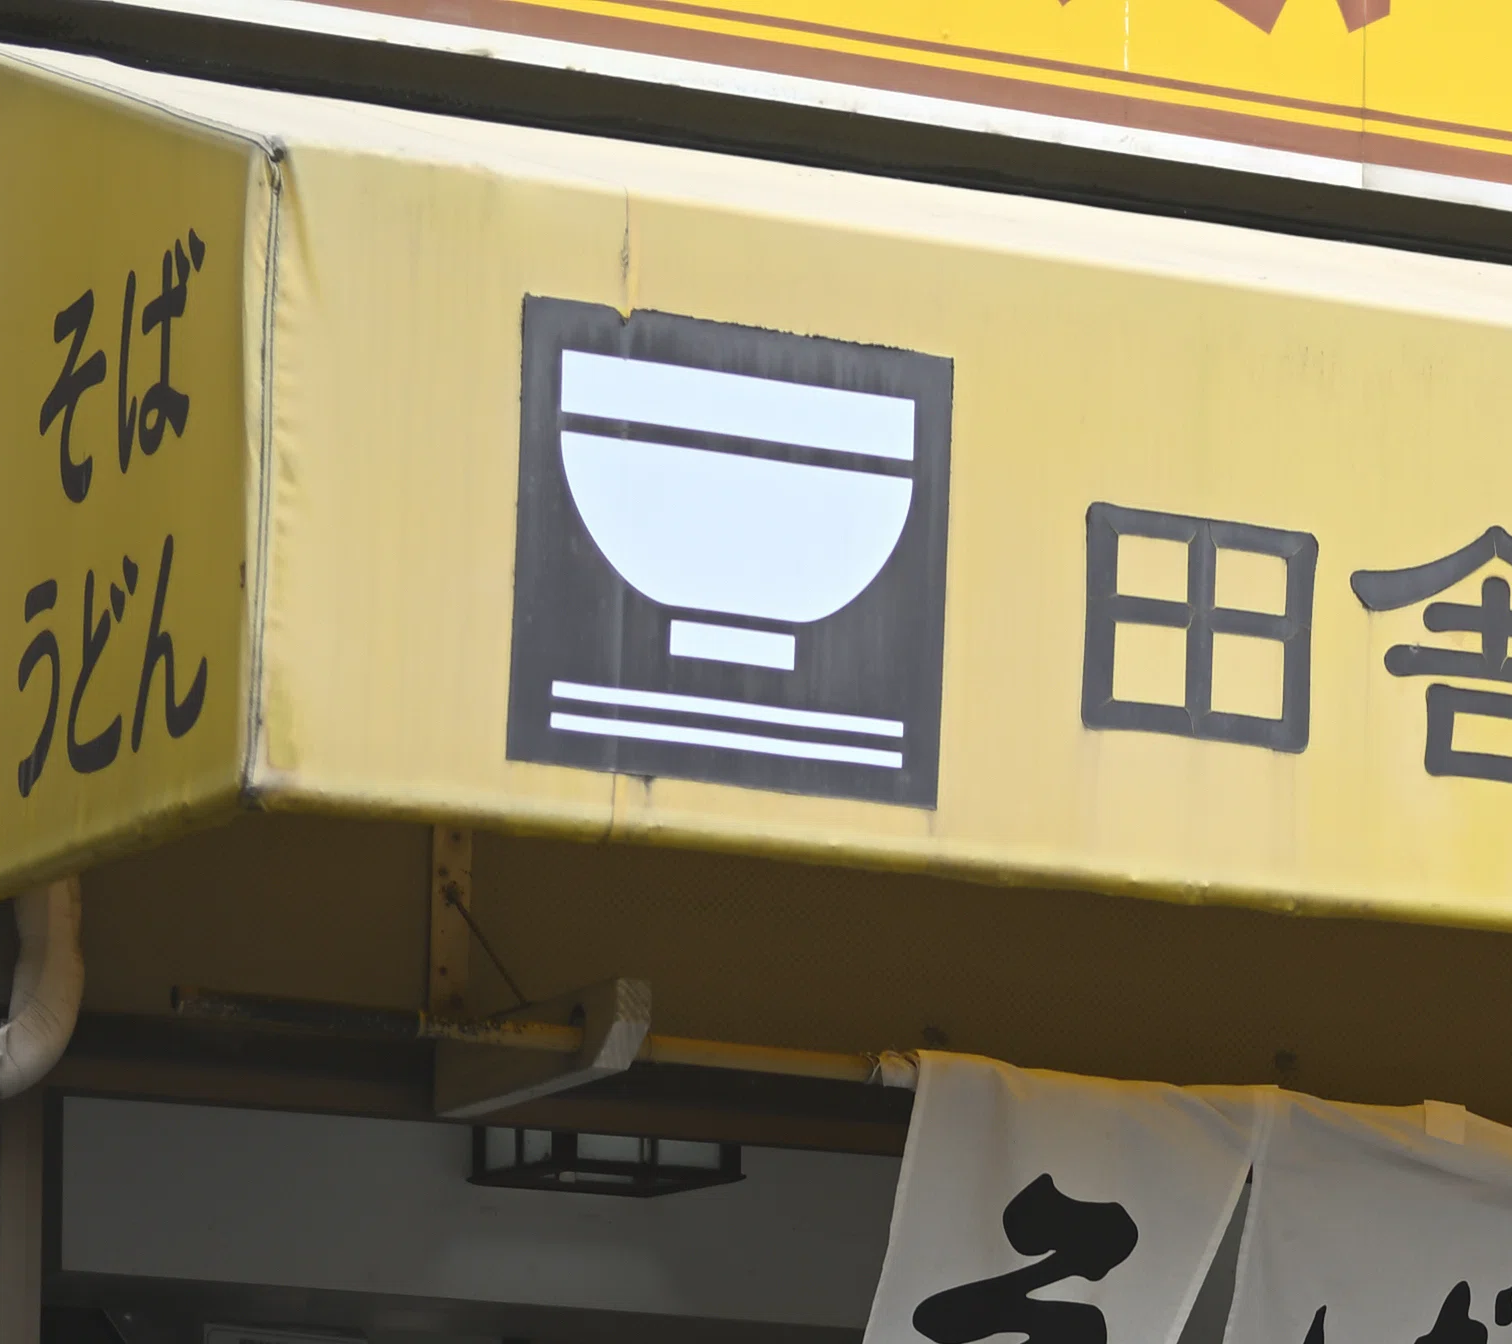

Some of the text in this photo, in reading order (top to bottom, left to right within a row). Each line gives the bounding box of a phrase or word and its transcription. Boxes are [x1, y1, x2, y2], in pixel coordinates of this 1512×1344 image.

[38, 227, 208, 504] そば
[17, 531, 210, 799] うどん
